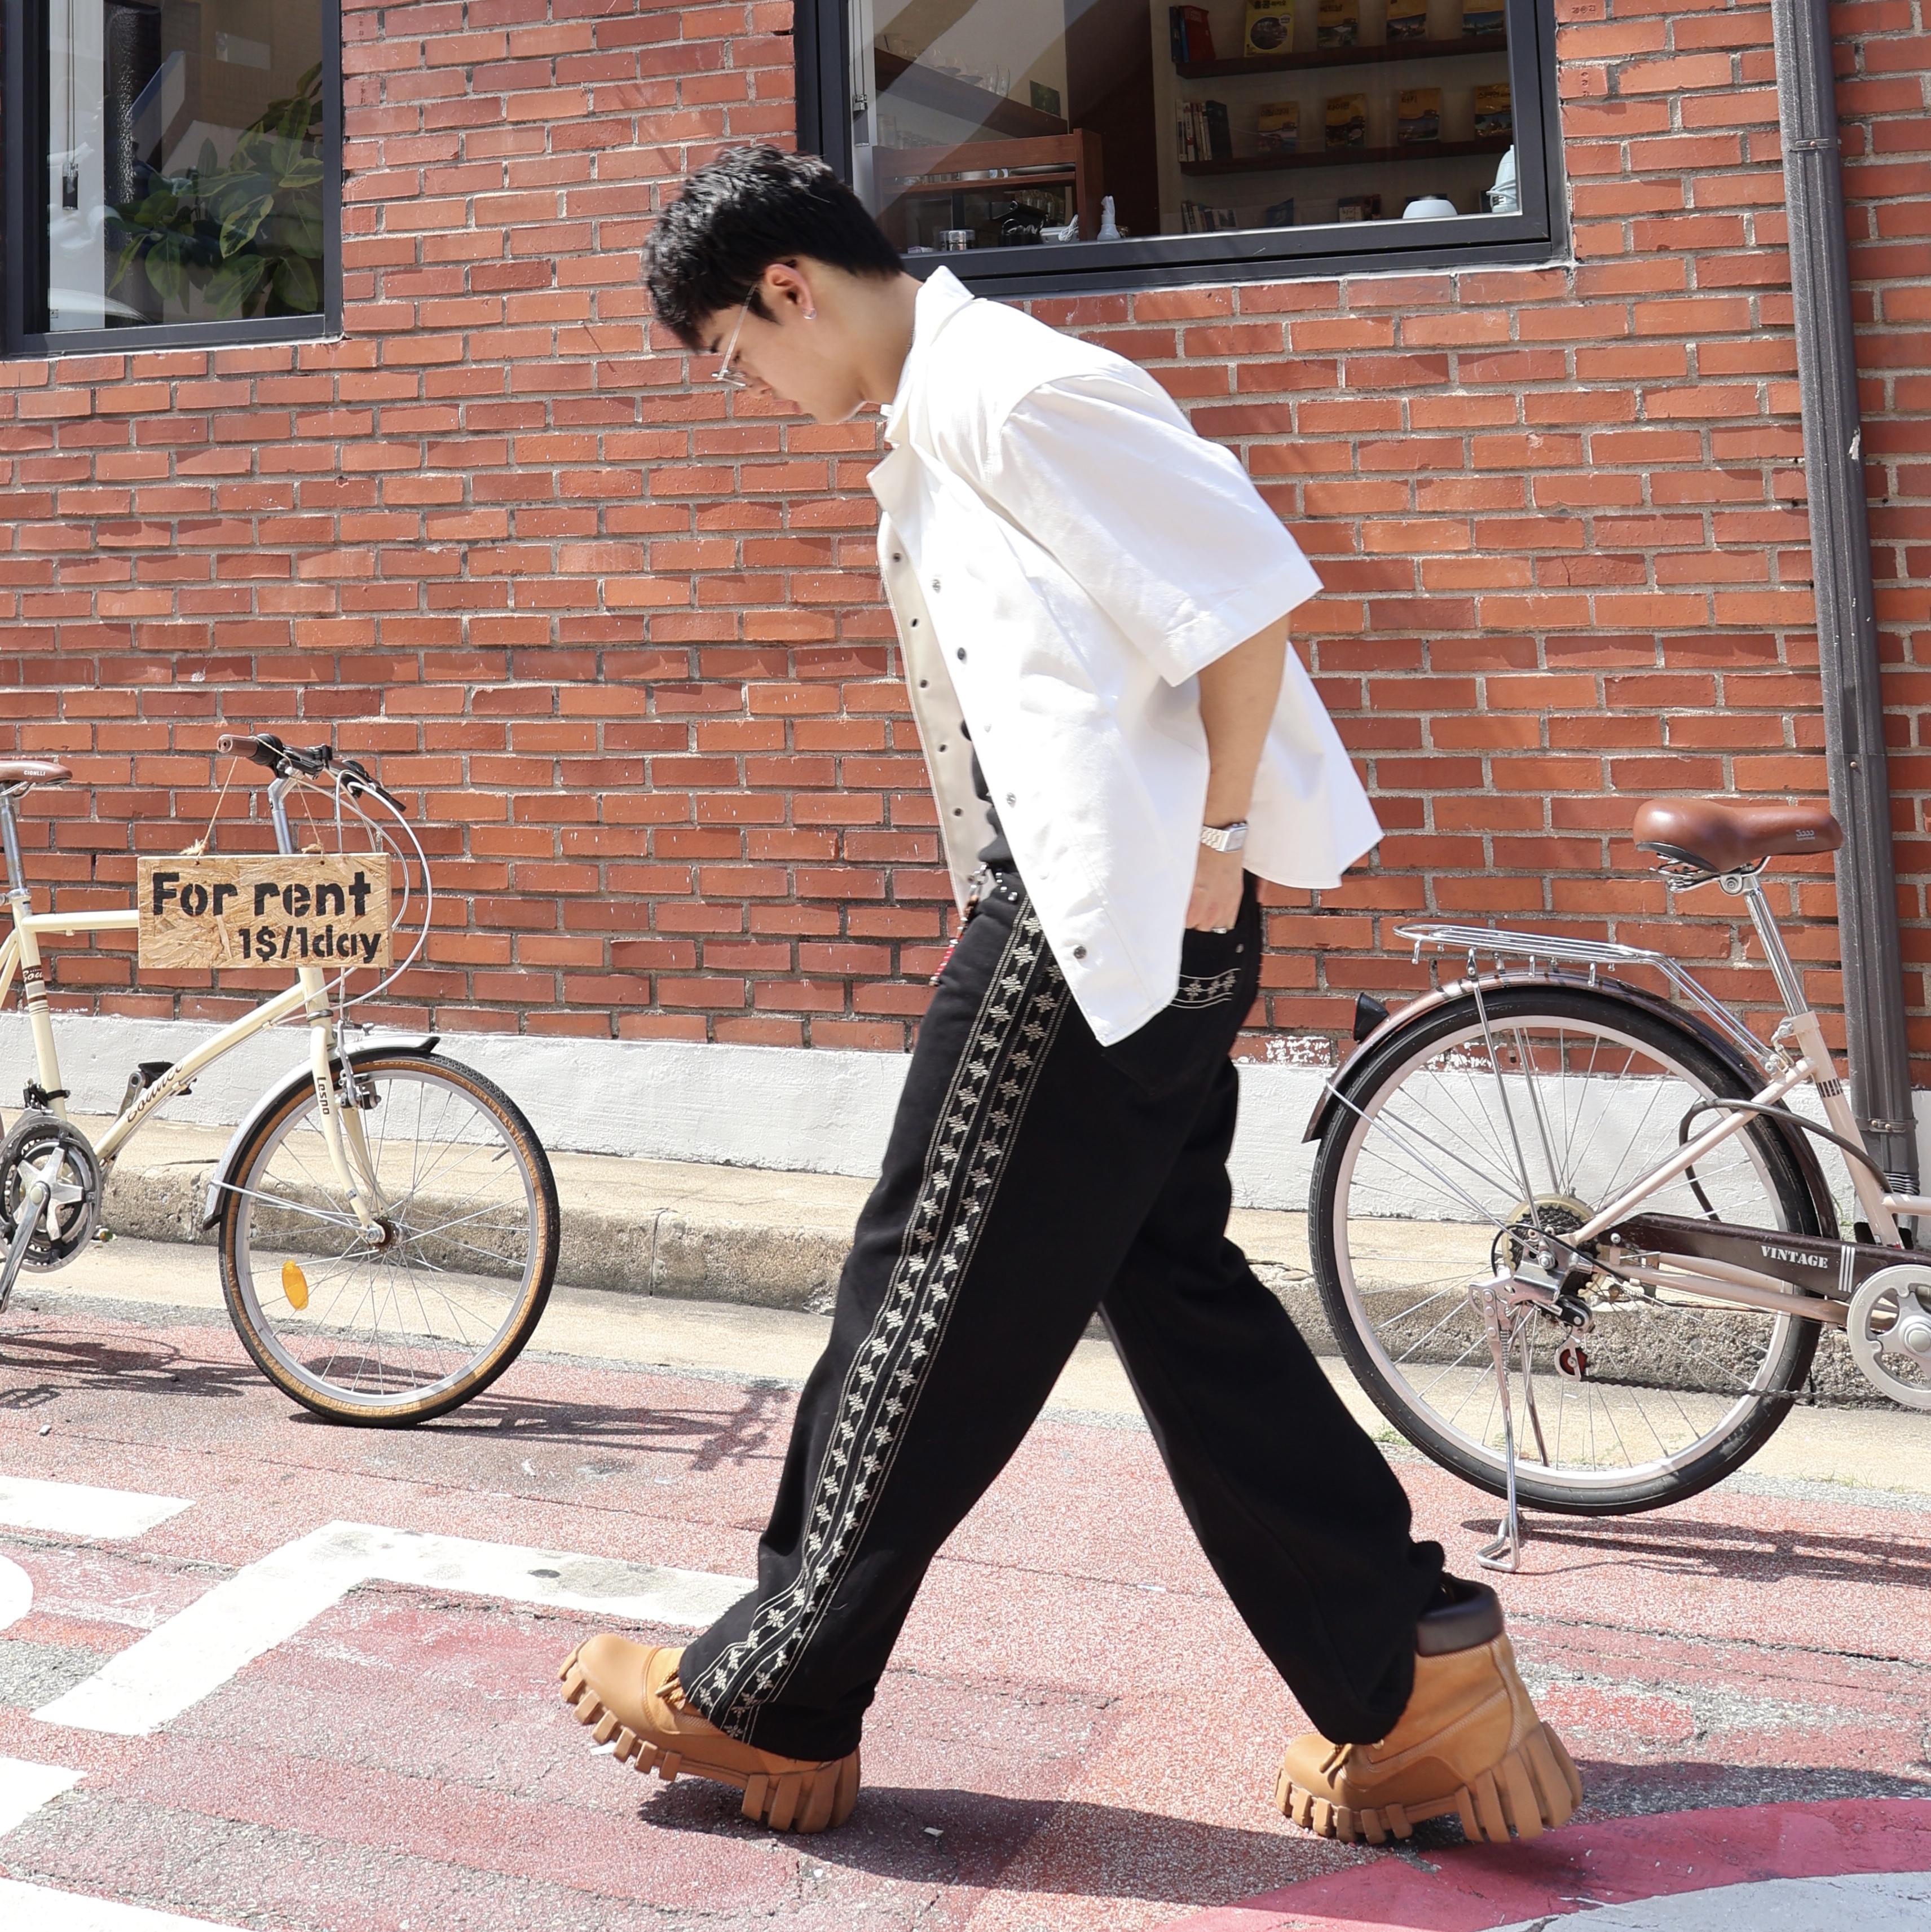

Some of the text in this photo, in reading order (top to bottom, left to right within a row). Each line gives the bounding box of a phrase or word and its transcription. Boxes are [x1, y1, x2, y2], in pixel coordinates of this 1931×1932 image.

[1328, 102, 1350, 111] 타이완
[1401, 95, 1417, 103] 터키
[1260, 108, 1289, 116] 이탈리아
[152, 871, 371, 918] For rent
[239, 924, 381, 963] 1$/1day
[1761, 1246, 1828, 1269] VINTAGE
